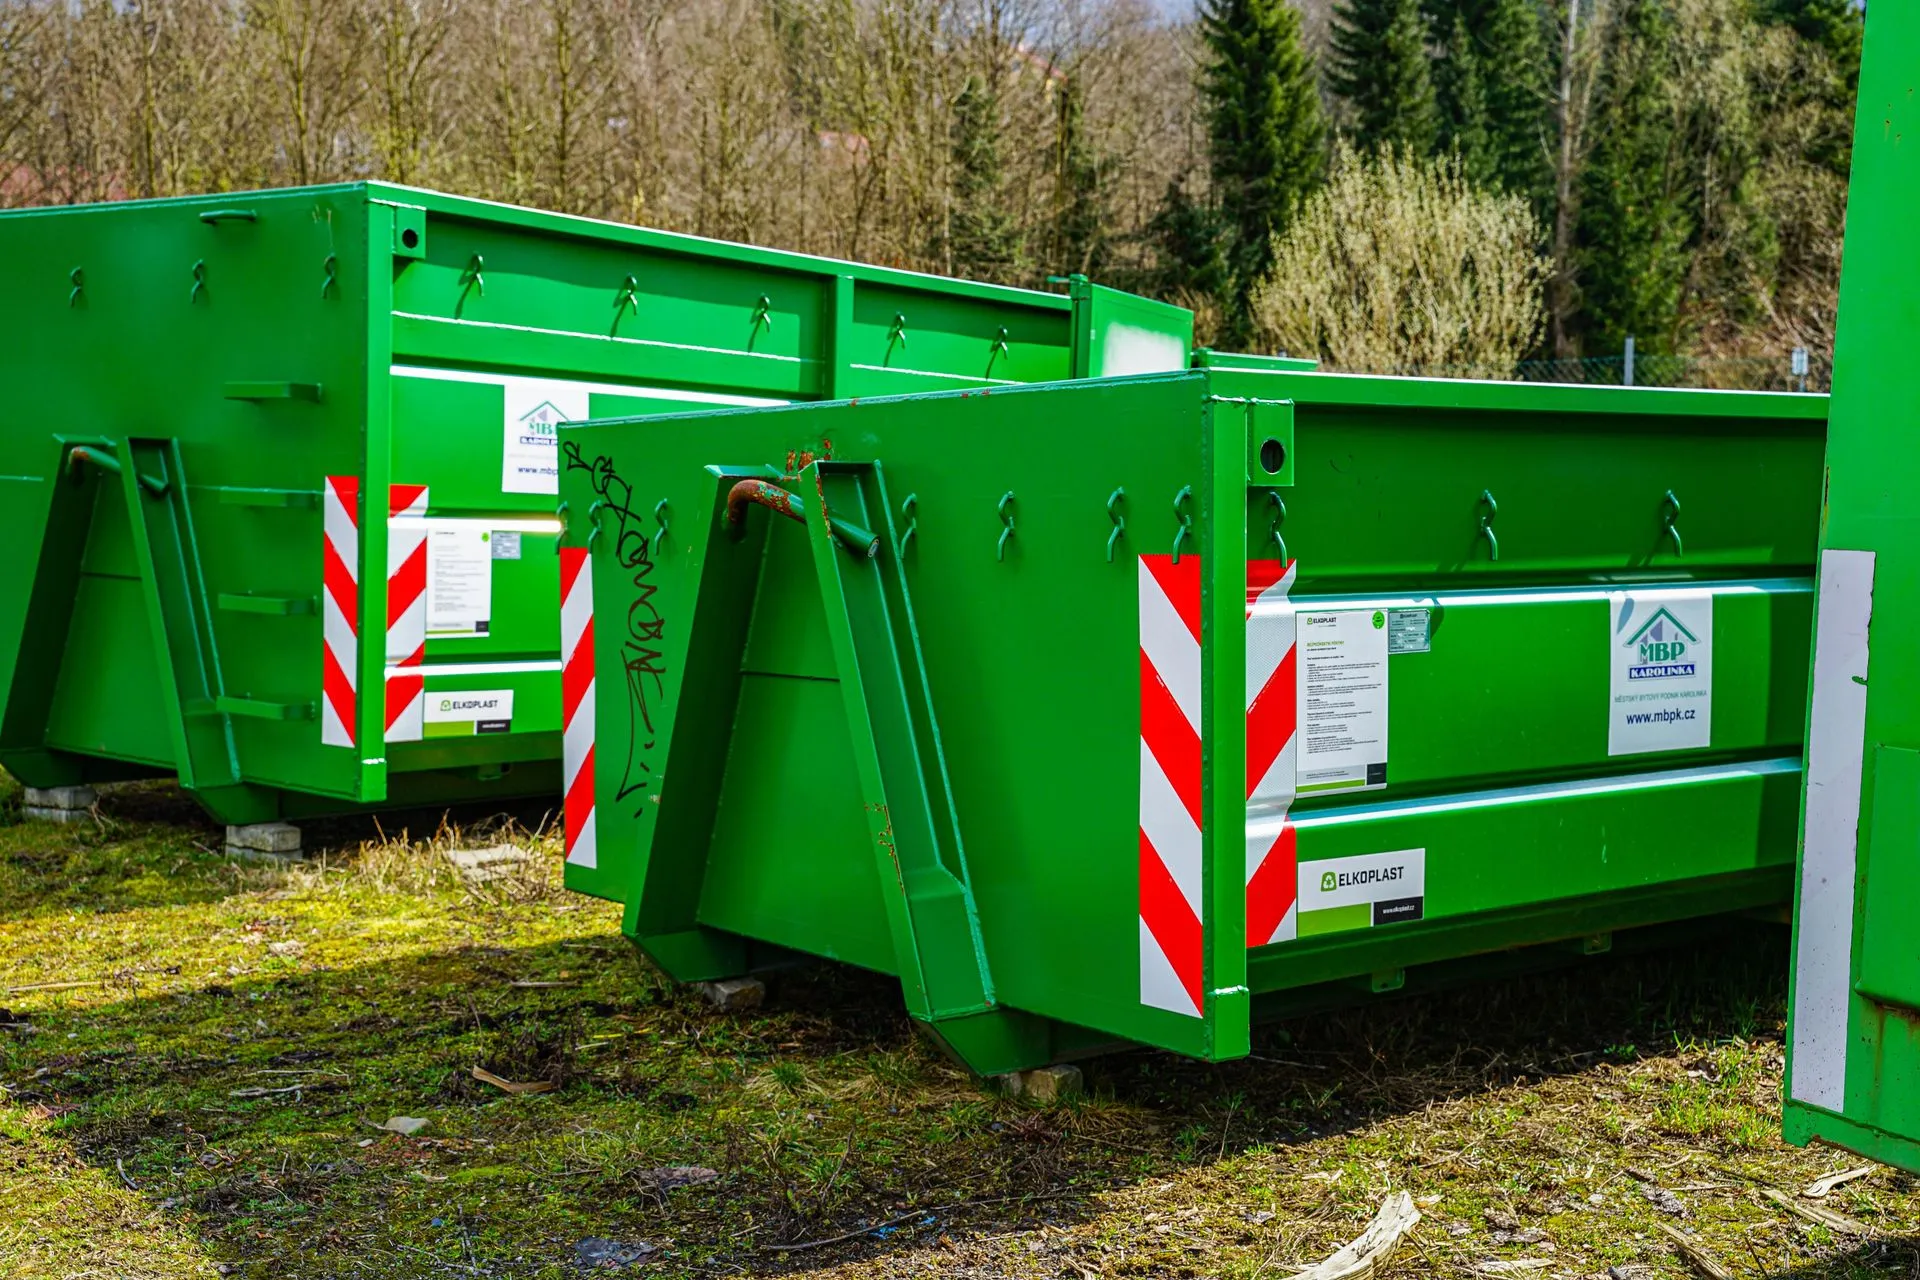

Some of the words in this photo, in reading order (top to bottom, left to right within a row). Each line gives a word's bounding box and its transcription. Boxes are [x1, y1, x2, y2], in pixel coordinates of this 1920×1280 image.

[529, 423, 557, 435] MB
[518, 466, 558, 476] www.mbp
[1640, 642, 1685, 662] MBP
[1630, 665, 1693, 679] KAROLINKA
[453, 700, 498, 709] ELKOPLAST
[1627, 708, 1695, 725] www.mbpk.cz
[1339, 866, 1404, 887] ELKOPLAST
